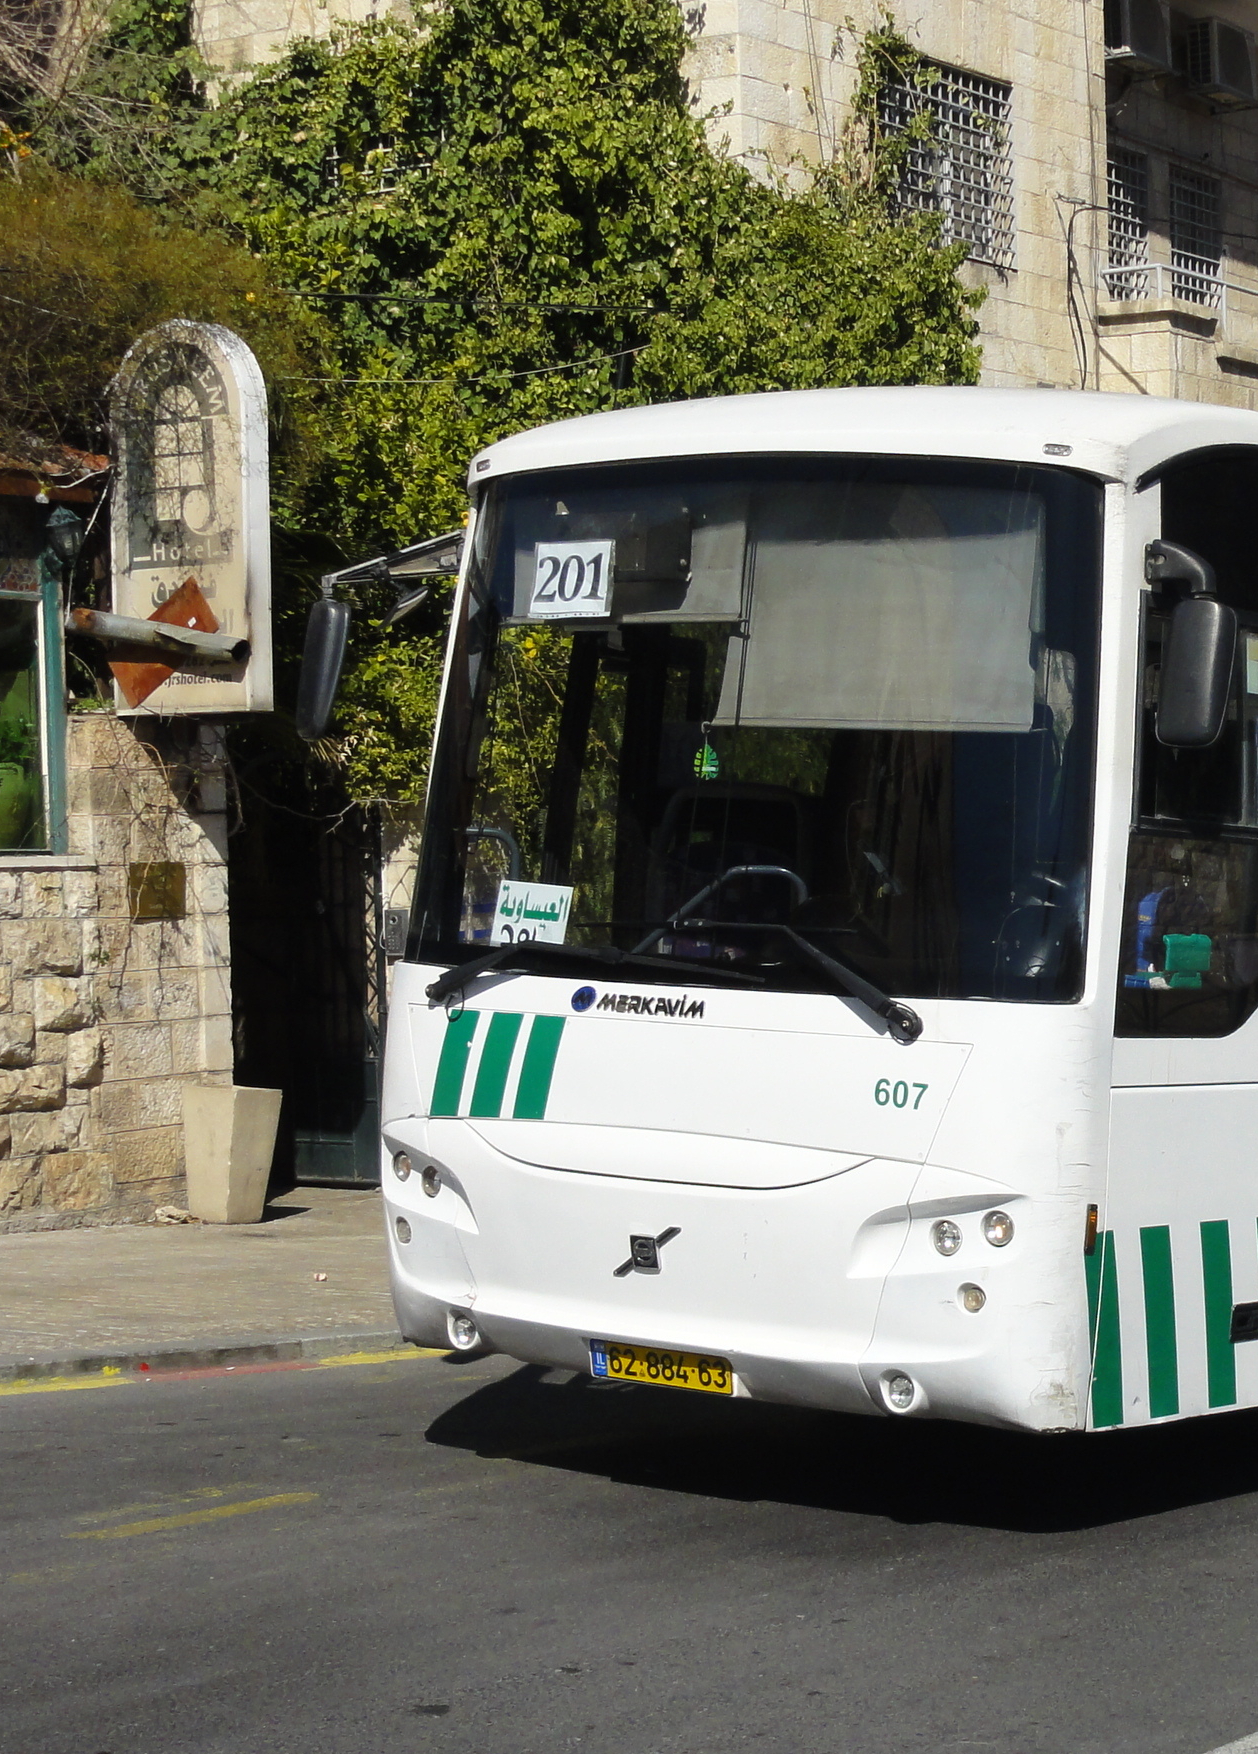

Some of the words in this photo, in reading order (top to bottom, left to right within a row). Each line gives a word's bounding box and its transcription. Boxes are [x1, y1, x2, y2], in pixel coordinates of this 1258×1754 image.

[152, 538, 212, 562] Hotel
[533, 552, 605, 603] 201
[874, 1078, 929, 1110] 607
[595, 1351, 606, 1365] IL
